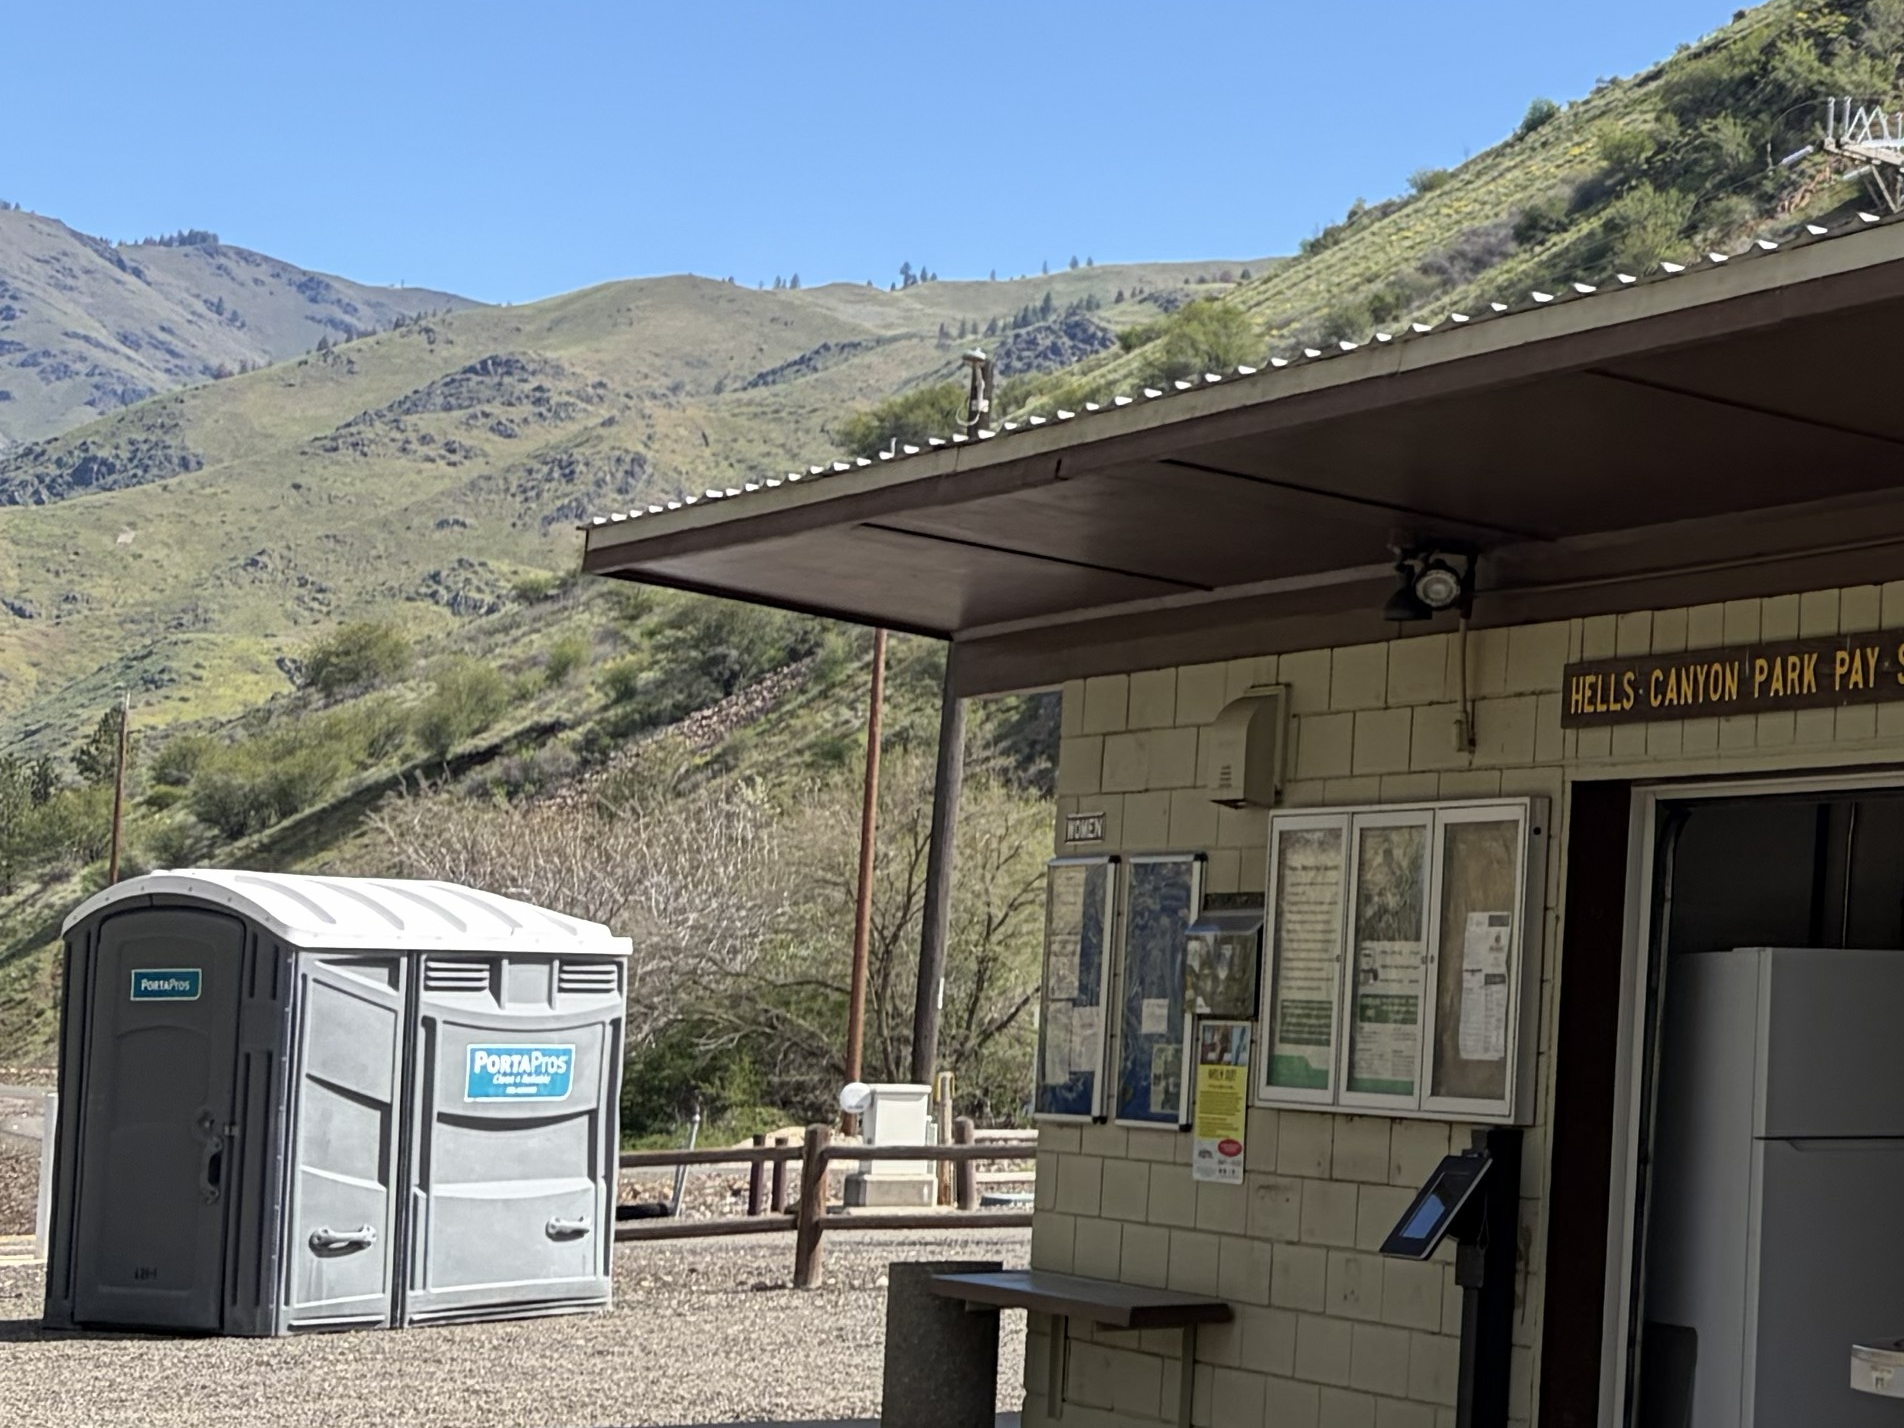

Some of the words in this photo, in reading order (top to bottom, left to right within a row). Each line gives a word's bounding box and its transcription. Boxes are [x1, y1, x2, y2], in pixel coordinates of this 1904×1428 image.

[1570, 671, 1635, 715] HELLS
[1650, 661, 1739, 708] CANYON
[1754, 652, 1818, 698] PARK
[1835, 646, 1879, 691] PAY
[1067, 818, 1103, 840] WOMEN
